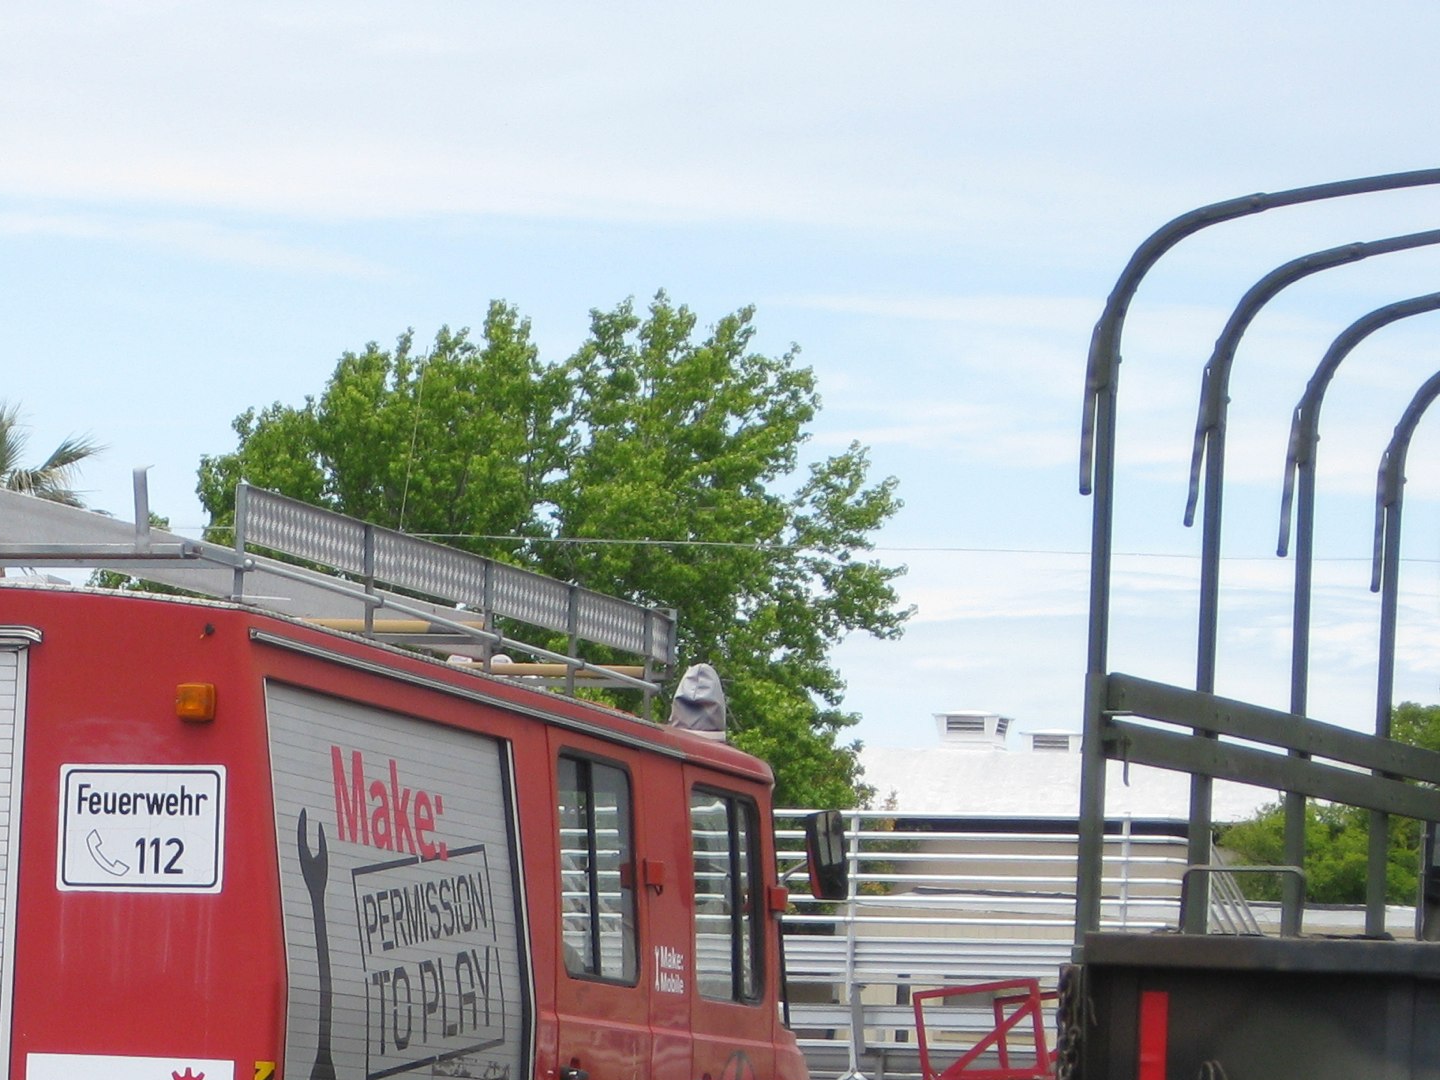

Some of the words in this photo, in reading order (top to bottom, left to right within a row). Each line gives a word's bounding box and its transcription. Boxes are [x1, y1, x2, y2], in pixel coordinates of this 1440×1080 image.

[76, 783, 209, 816] Feuerwehr
[330, 745, 448, 861] Make:
[135, 837, 186, 875] 112
[362, 870, 487, 955] PERMISSION
[372, 965, 412, 1056] TO
[419, 945, 490, 1044] PLAY
